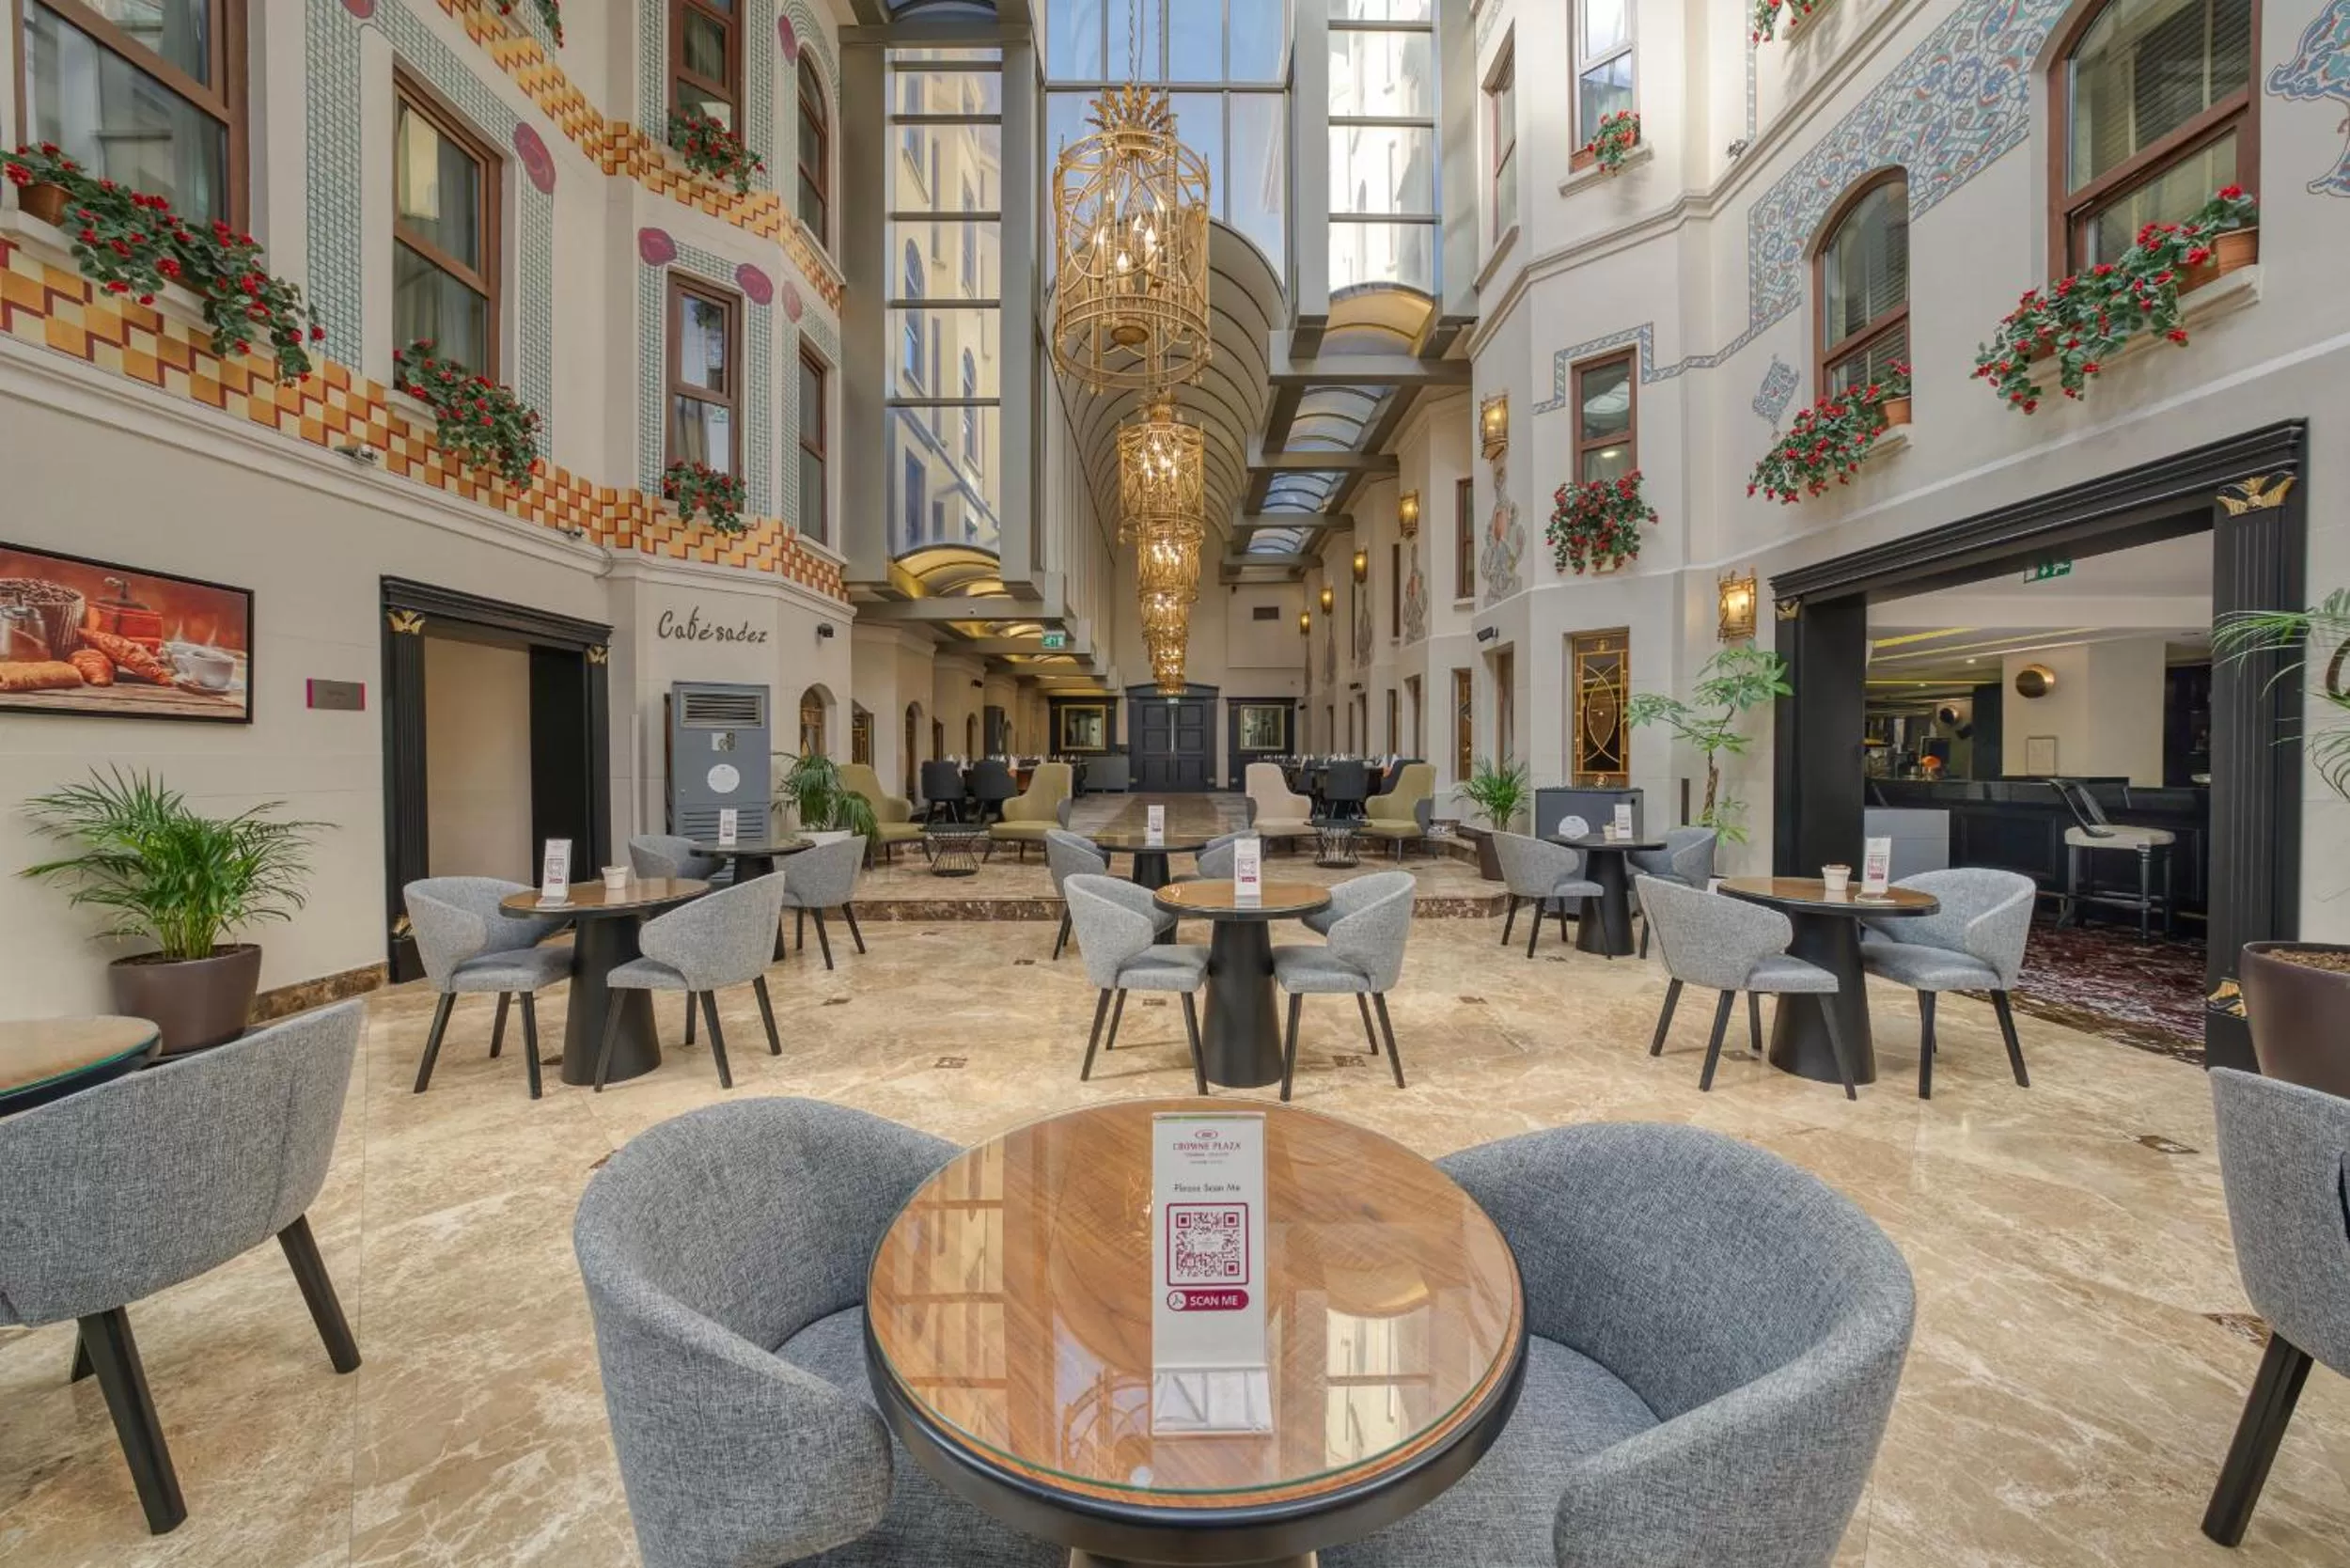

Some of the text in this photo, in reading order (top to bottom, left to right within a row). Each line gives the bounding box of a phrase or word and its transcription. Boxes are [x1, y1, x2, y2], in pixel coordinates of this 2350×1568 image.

[1173, 1141, 1242, 1151] CROWNE PLAZA
[1174, 1183, 1241, 1192] Please Scan Me
[1189, 1294, 1239, 1307] SCAN ME
